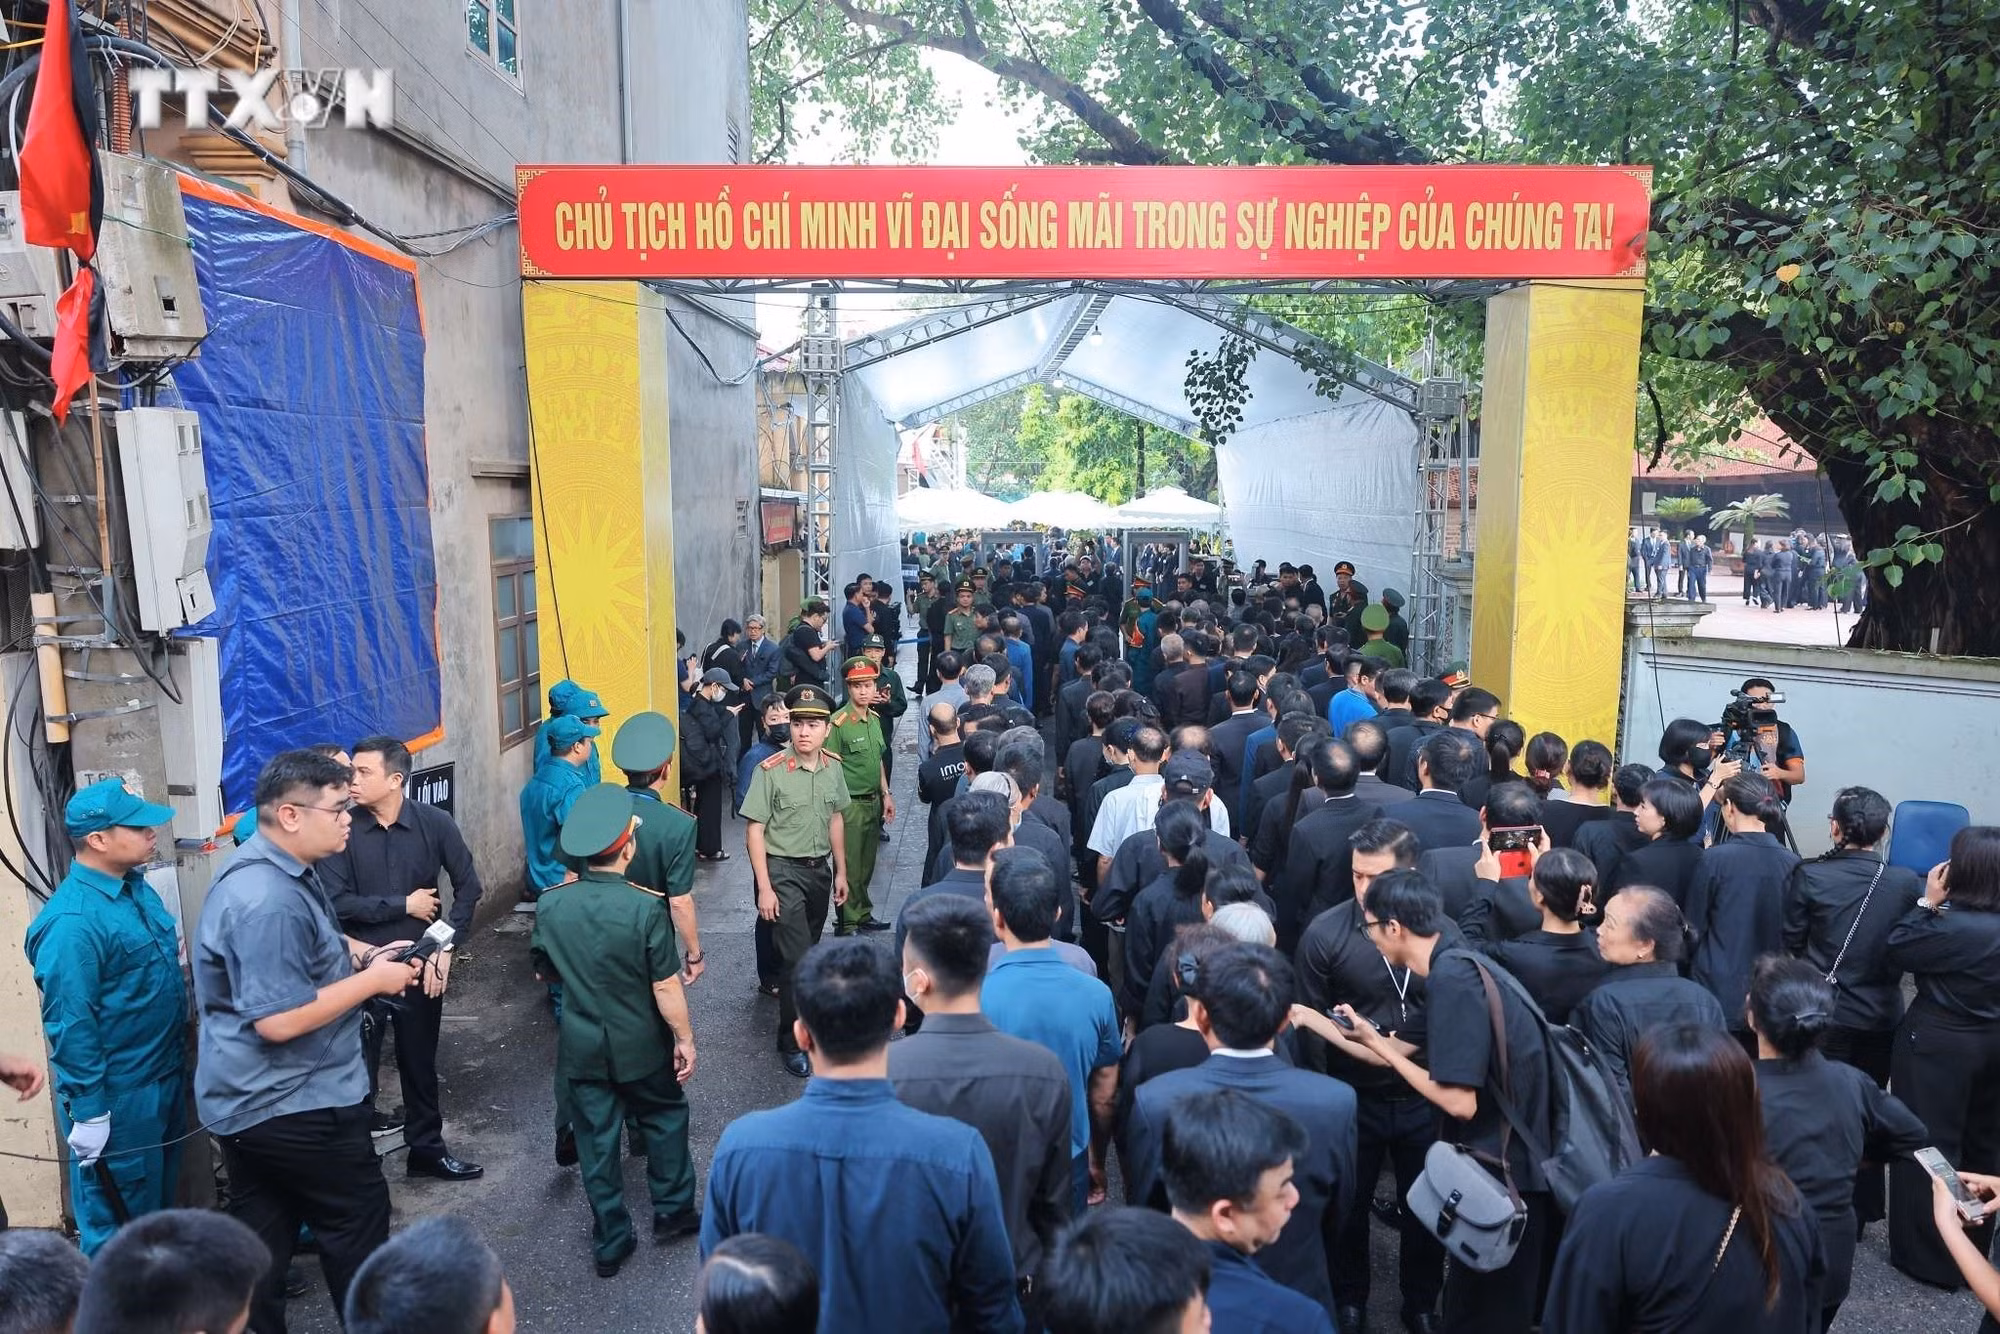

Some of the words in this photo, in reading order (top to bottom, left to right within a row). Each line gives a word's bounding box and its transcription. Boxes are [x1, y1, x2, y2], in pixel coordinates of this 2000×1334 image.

[555, 185, 614, 250] CHỦ
[621, 202, 687, 261] TỊCH
[694, 184, 734, 250] HỒ
[742, 190, 791, 250] CHÍ
[800, 201, 877, 250] MINH
[885, 191, 915, 249] VĨ
[921, 201, 970, 261] ĐẠI
[979, 182, 1058, 250] SỐNG
[1068, 191, 1123, 250] MÃI
[1132, 201, 1226, 250] TRONG
[1235, 196, 1279, 262] SỰ
[1284, 191, 1392, 262] NGHIỆP
[1398, 185, 1456, 251] CỦA
[1465, 191, 1564, 251] CHÚNG
[1573, 202, 1617, 252] TA!
[432, 776, 449, 804] VÀO
